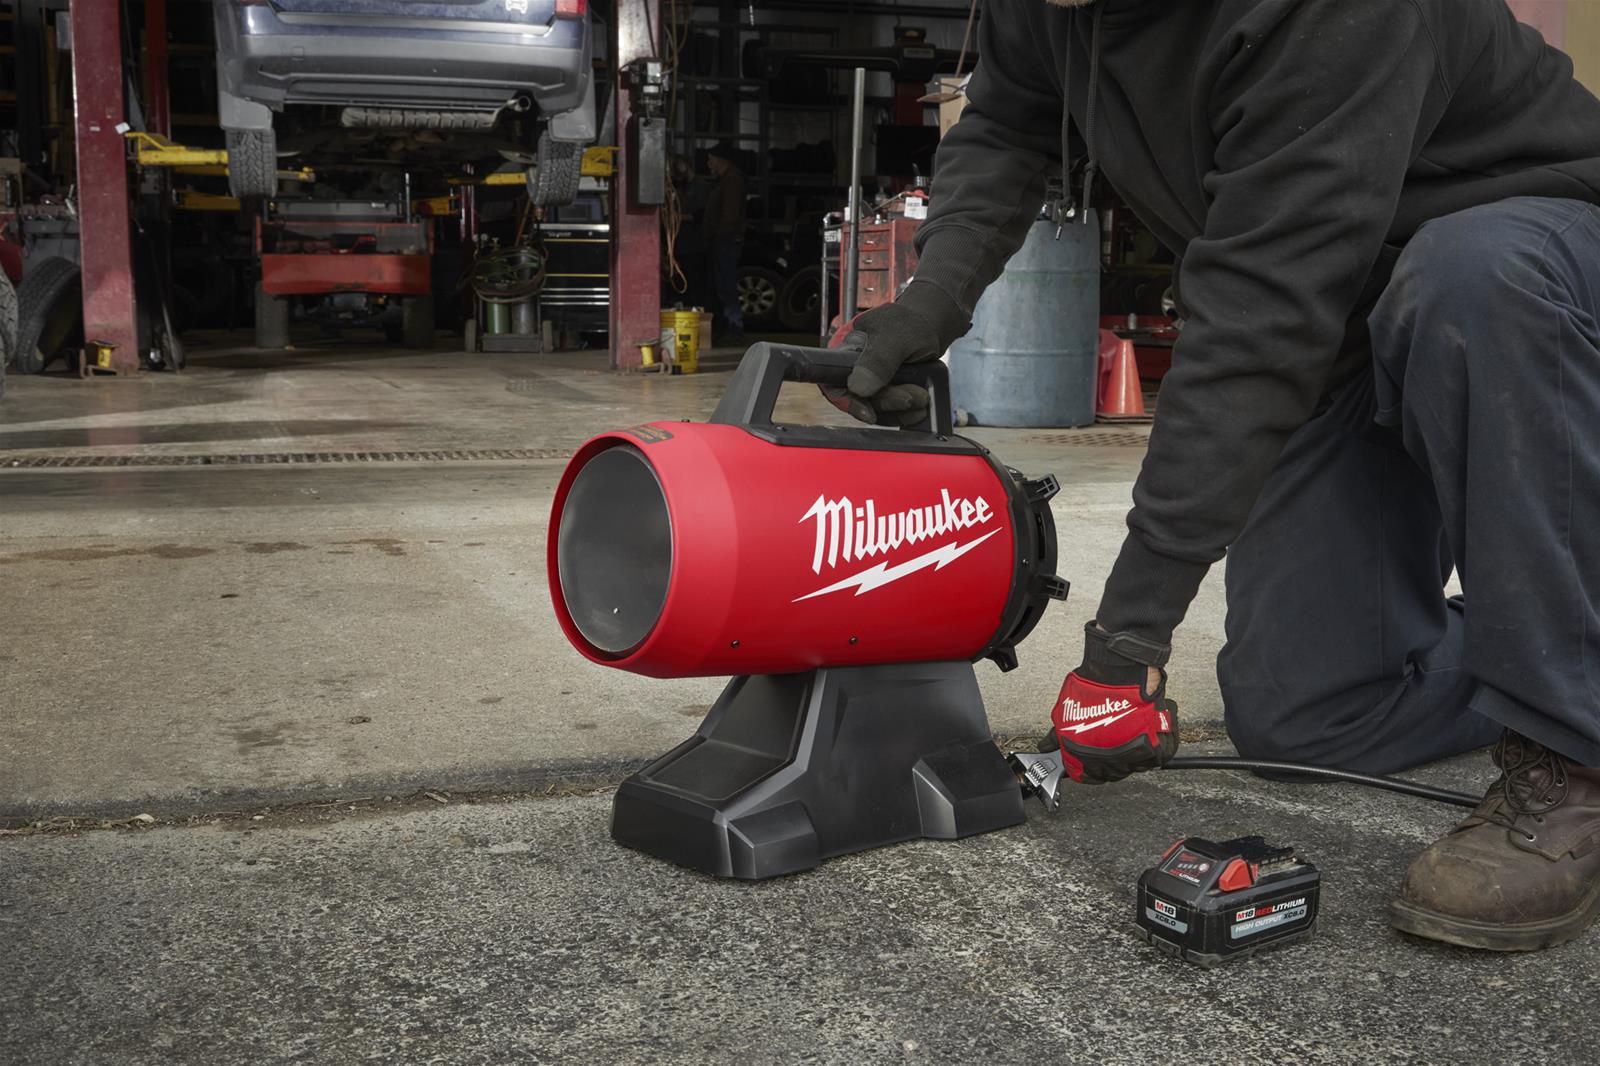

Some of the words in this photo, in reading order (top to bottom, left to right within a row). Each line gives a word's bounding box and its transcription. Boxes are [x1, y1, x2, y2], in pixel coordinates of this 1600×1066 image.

[798, 488, 994, 576] Milwaukee
[1062, 696, 1132, 723] Milwaukee
[1155, 900, 1175, 915] M18
[1237, 909, 1254, 920] M18
[1235, 921, 1254, 933] HIGH
[1254, 914, 1283, 926] OUTPUT
